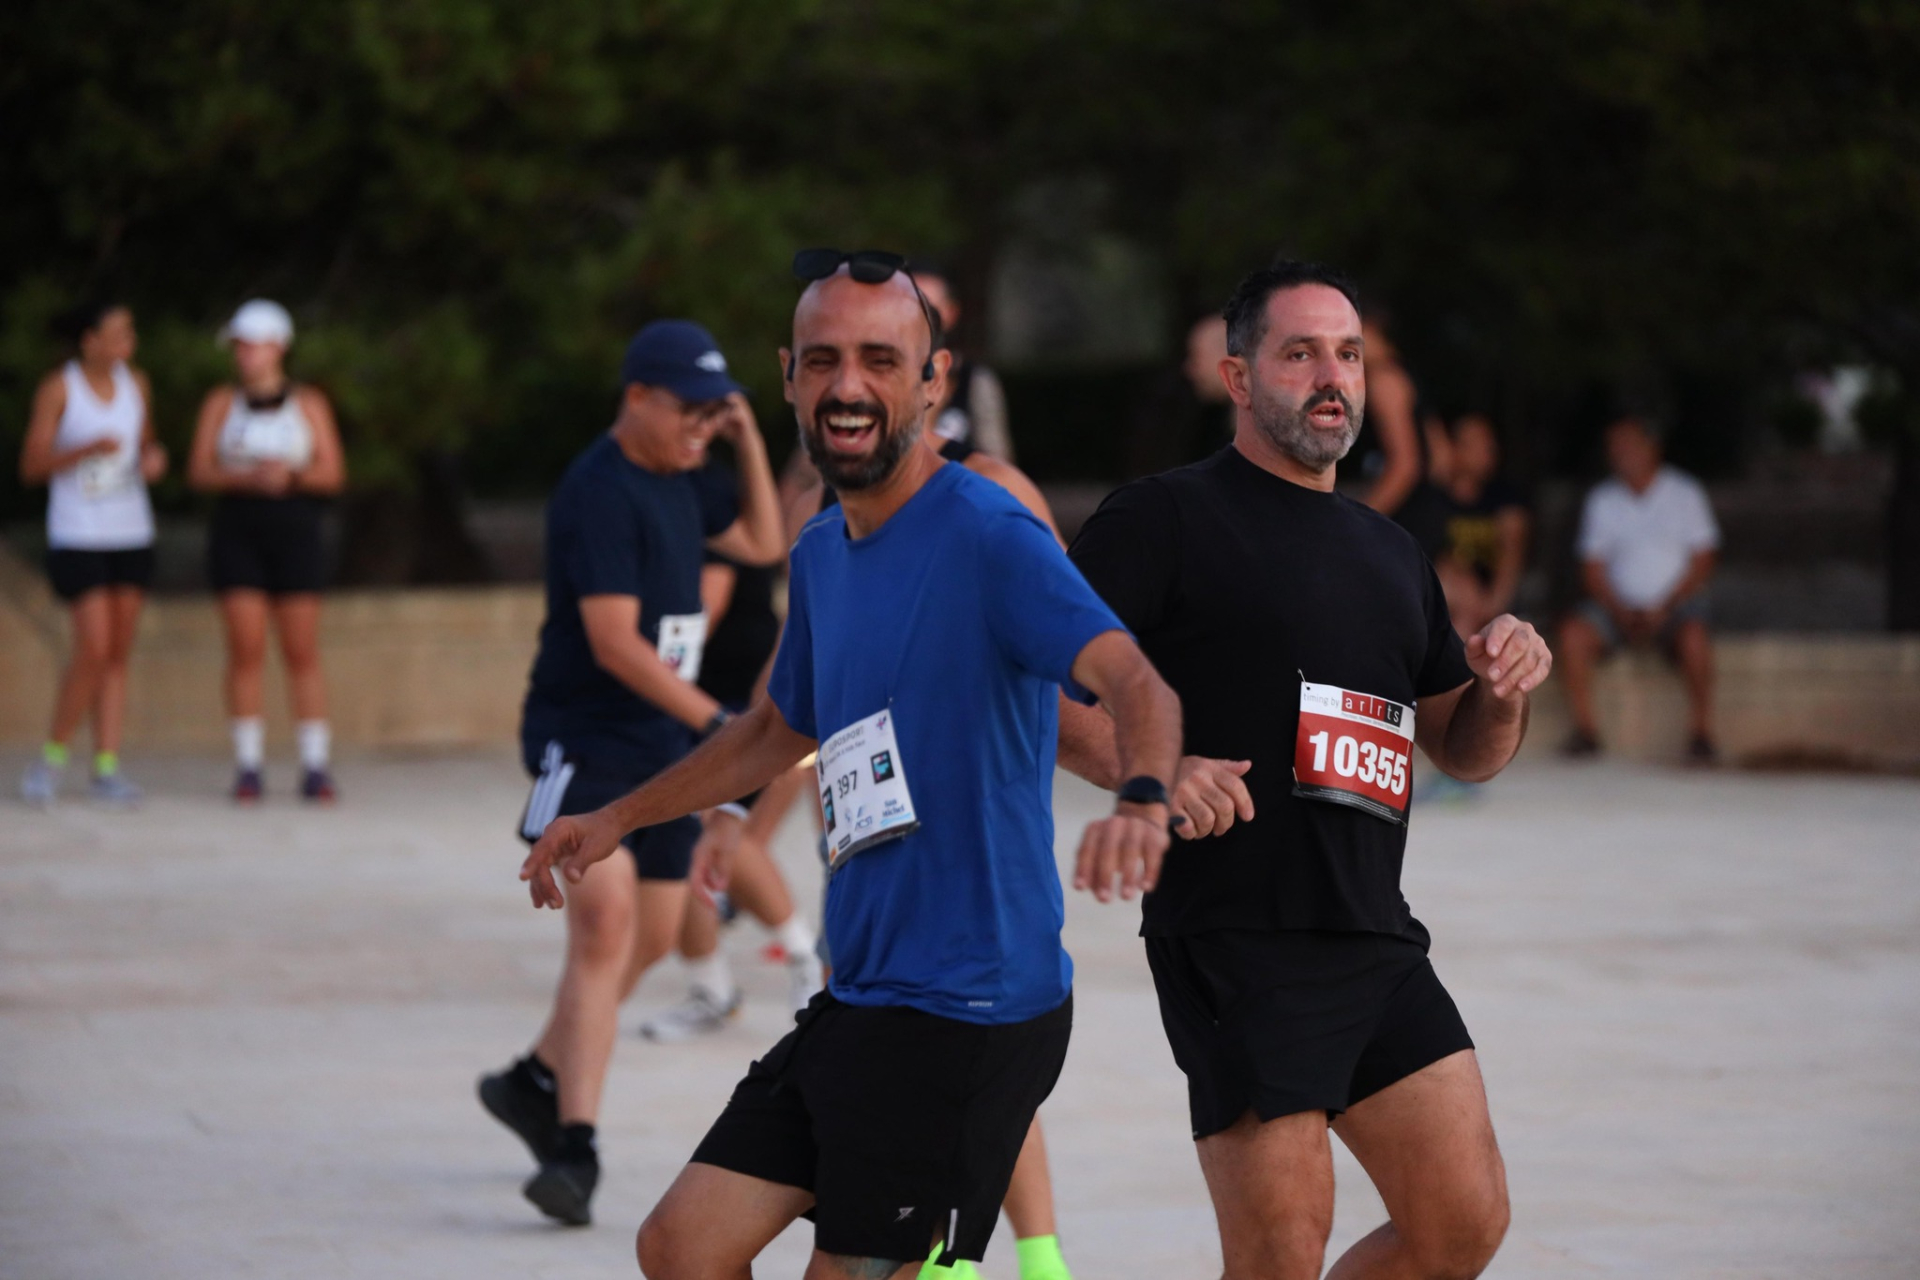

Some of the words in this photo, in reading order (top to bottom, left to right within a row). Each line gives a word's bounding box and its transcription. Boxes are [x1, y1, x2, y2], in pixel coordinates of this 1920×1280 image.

[1303, 693, 1328, 707] timing
[1331, 696, 1340, 708] by
[1309, 730, 1408, 796] 10355
